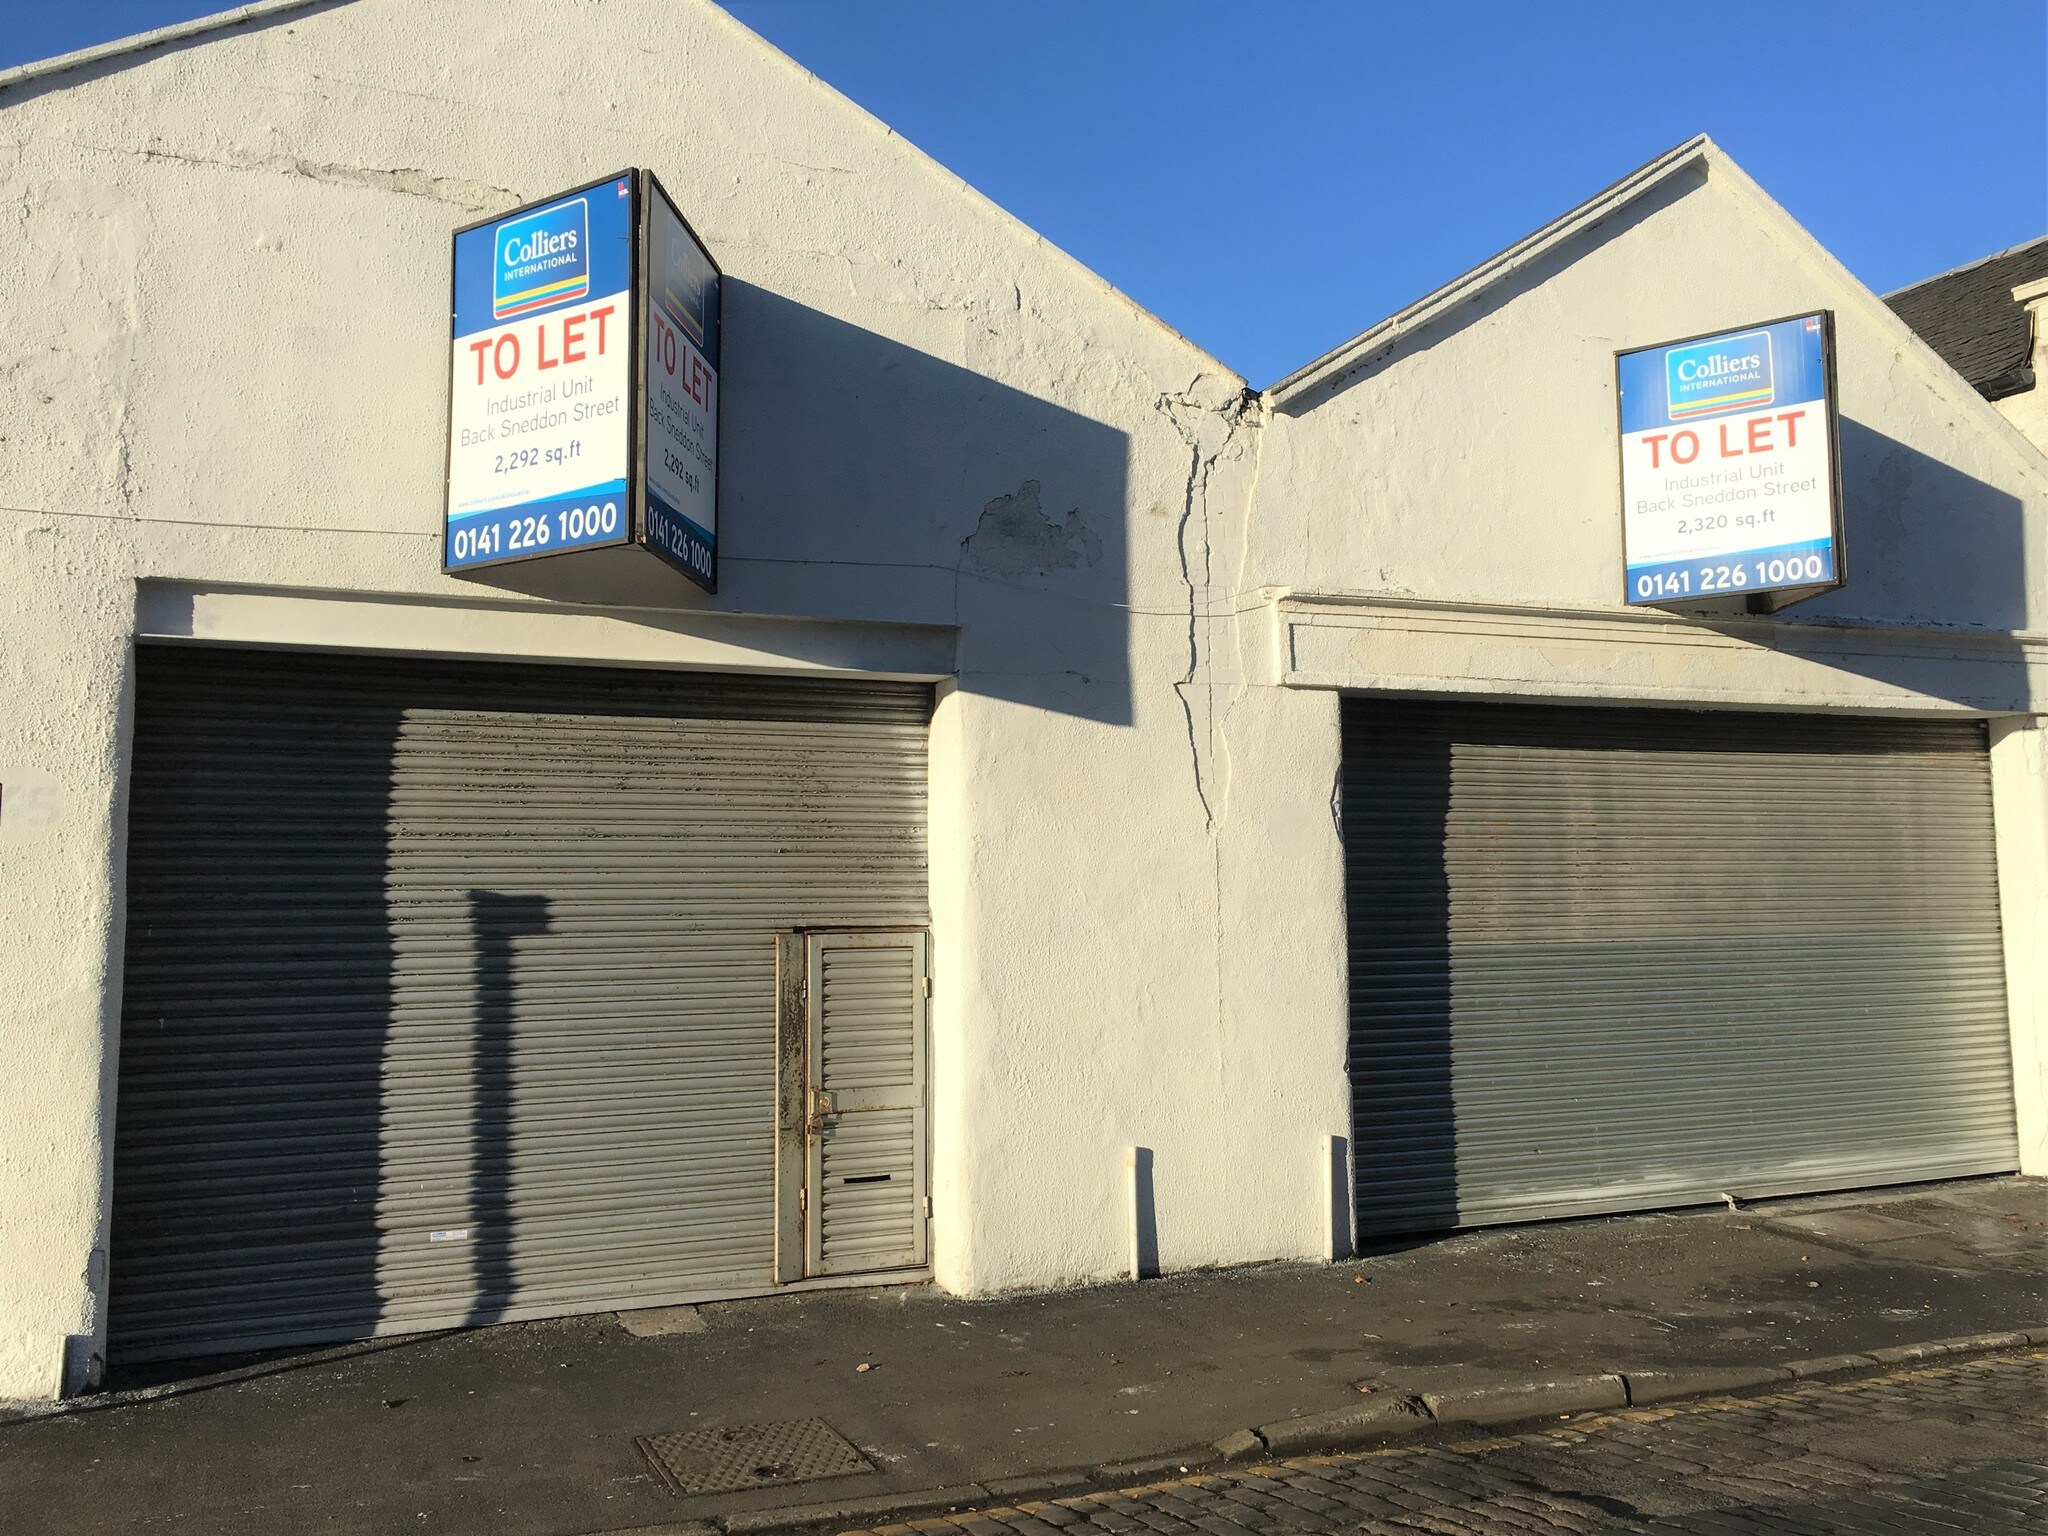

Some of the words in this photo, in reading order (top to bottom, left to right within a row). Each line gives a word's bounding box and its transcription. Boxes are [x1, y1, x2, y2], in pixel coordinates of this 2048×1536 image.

[504, 228, 577, 266] Colliers
[504, 253, 577, 281] INTERNATIONAL
[470, 333, 520, 385] TO
[538, 305, 615, 370] LET
[654, 312, 676, 376] TO
[682, 344, 712, 412] LET
[1678, 353, 1760, 381] Colliers
[1680, 371, 1761, 392] INTERNATIONAL
[487, 387, 556, 416] Industrial
[562, 377, 593, 398] Unit
[660, 383, 690, 427] Industrial
[692, 414, 704, 439] Unit
[461, 424, 494, 446] Back
[501, 411, 567, 438] Sneddon
[573, 397, 619, 421] Street
[650, 397, 665, 429] Back
[667, 416, 694, 456] Sneddon
[695, 443, 712, 473] Street
[1642, 430, 1700, 468] TO
[1720, 411, 1805, 458] LET
[494, 448, 538, 475] 2,292
[545, 440, 581, 465] sq.ft
[664, 449, 684, 480] 2,292
[685, 471, 700, 494] sq.ft
[1665, 469, 1742, 492] Industrial
[1750, 461, 1784, 479] Unit
[1637, 496, 1676, 514] Back
[1682, 485, 1756, 508] Sneddon
[1764, 477, 1816, 496] Street
[454, 524, 500, 558] 0141
[509, 515, 549, 550] 226
[558, 502, 616, 541] 1000
[648, 506, 669, 548] 0141
[671, 524, 688, 562] 226
[691, 539, 712, 578] 1000
[1678, 514, 1728, 535] 2,320
[1735, 509, 1775, 529] sq.ft
[1637, 570, 1690, 597] 0141
[1700, 563, 1747, 590] 226
[1756, 555, 1822, 584] 1000
